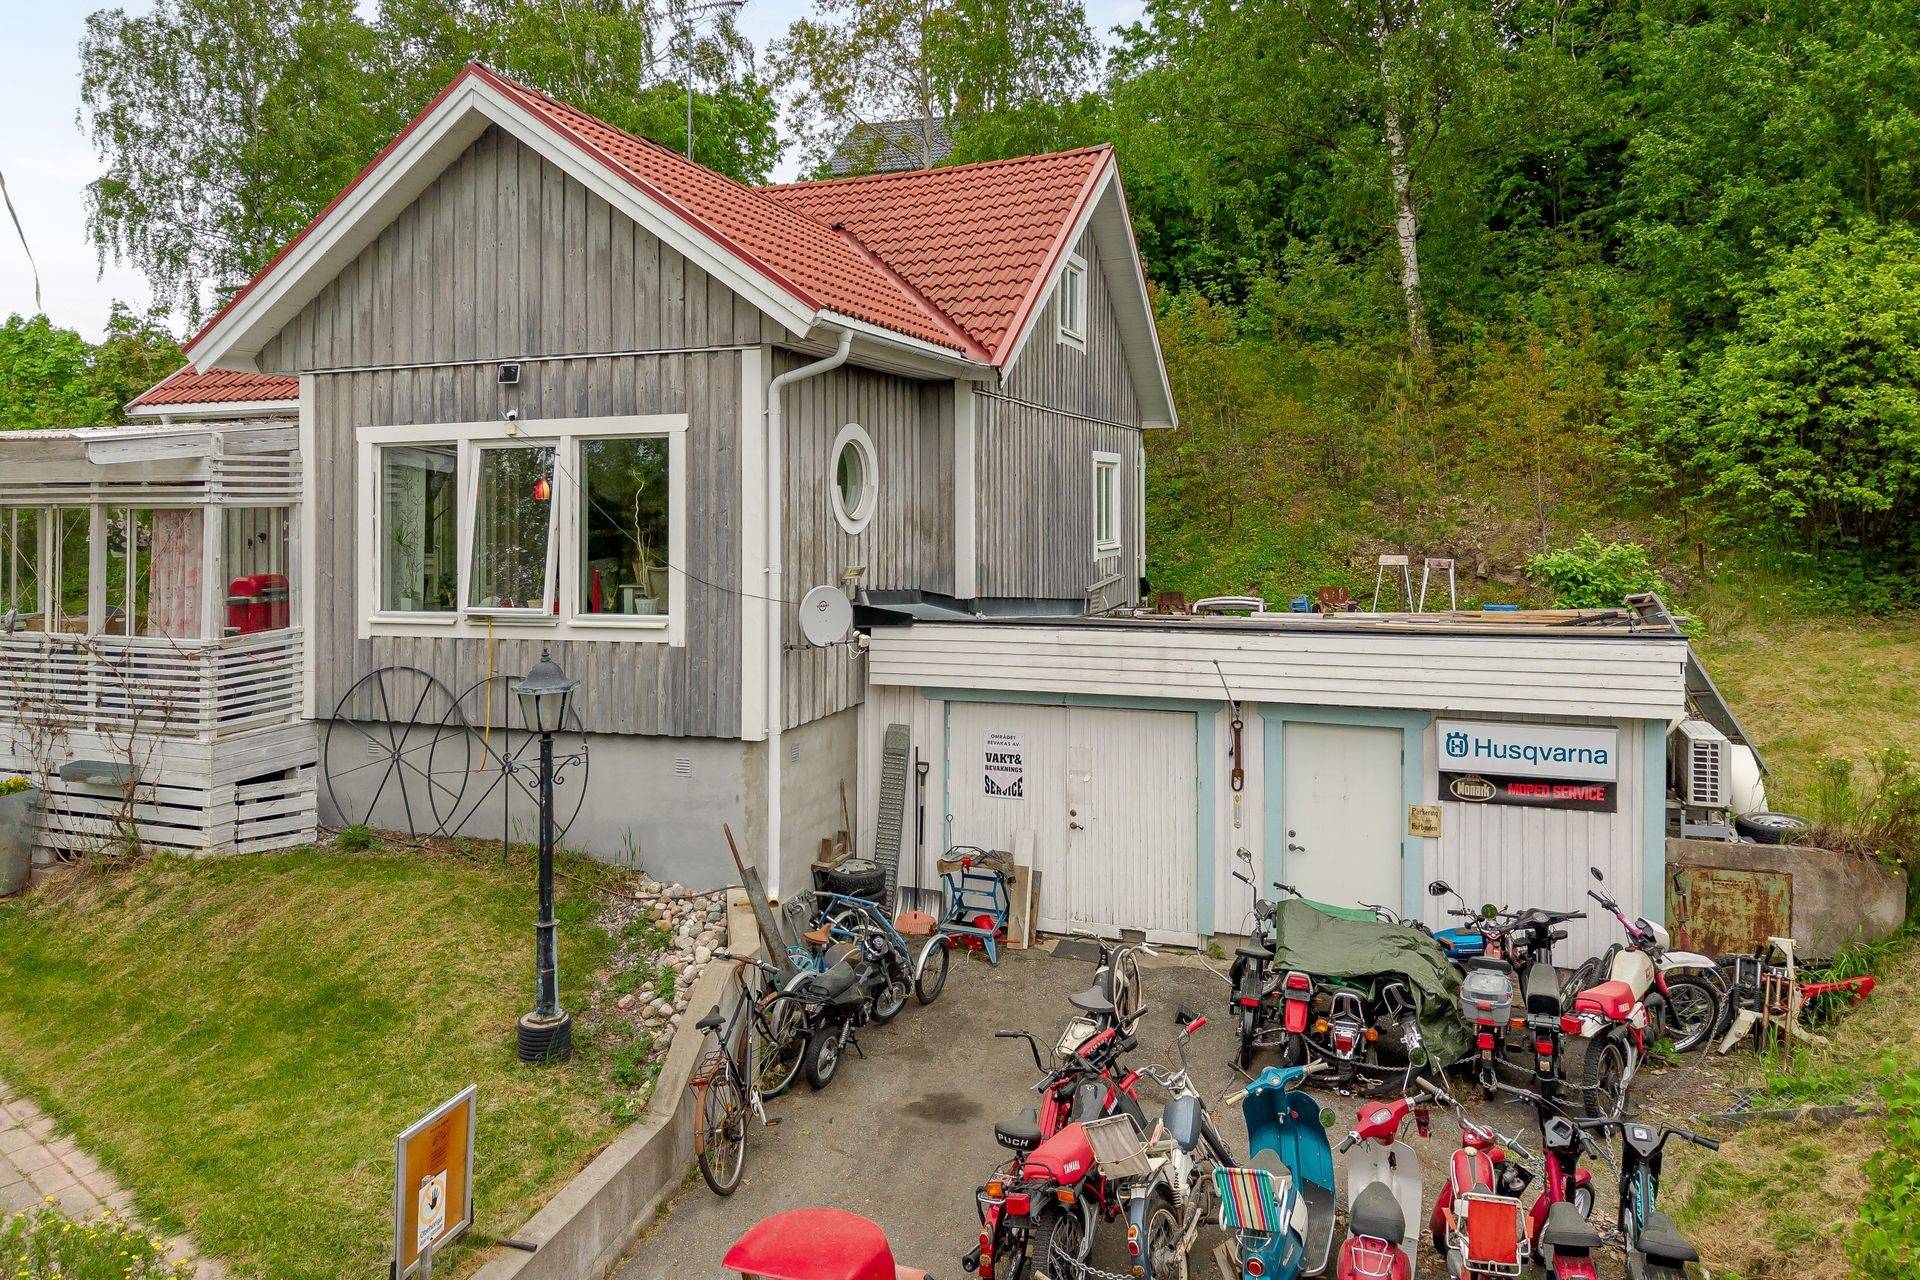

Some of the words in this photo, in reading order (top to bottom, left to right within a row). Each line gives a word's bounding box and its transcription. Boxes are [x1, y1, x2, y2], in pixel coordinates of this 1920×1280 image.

[985, 752, 1022, 765] VAKT&
[1474, 738, 1608, 765] Husqvarna
[985, 765, 1023, 773] BEVAKNINGS
[985, 774, 1023, 797] SERVICE
[1456, 781, 1491, 798] Monark
[1506, 782, 1550, 798] MOPED
[1552, 785, 1605, 801] SERVICE
[997, 1133, 1029, 1147] PUCH
